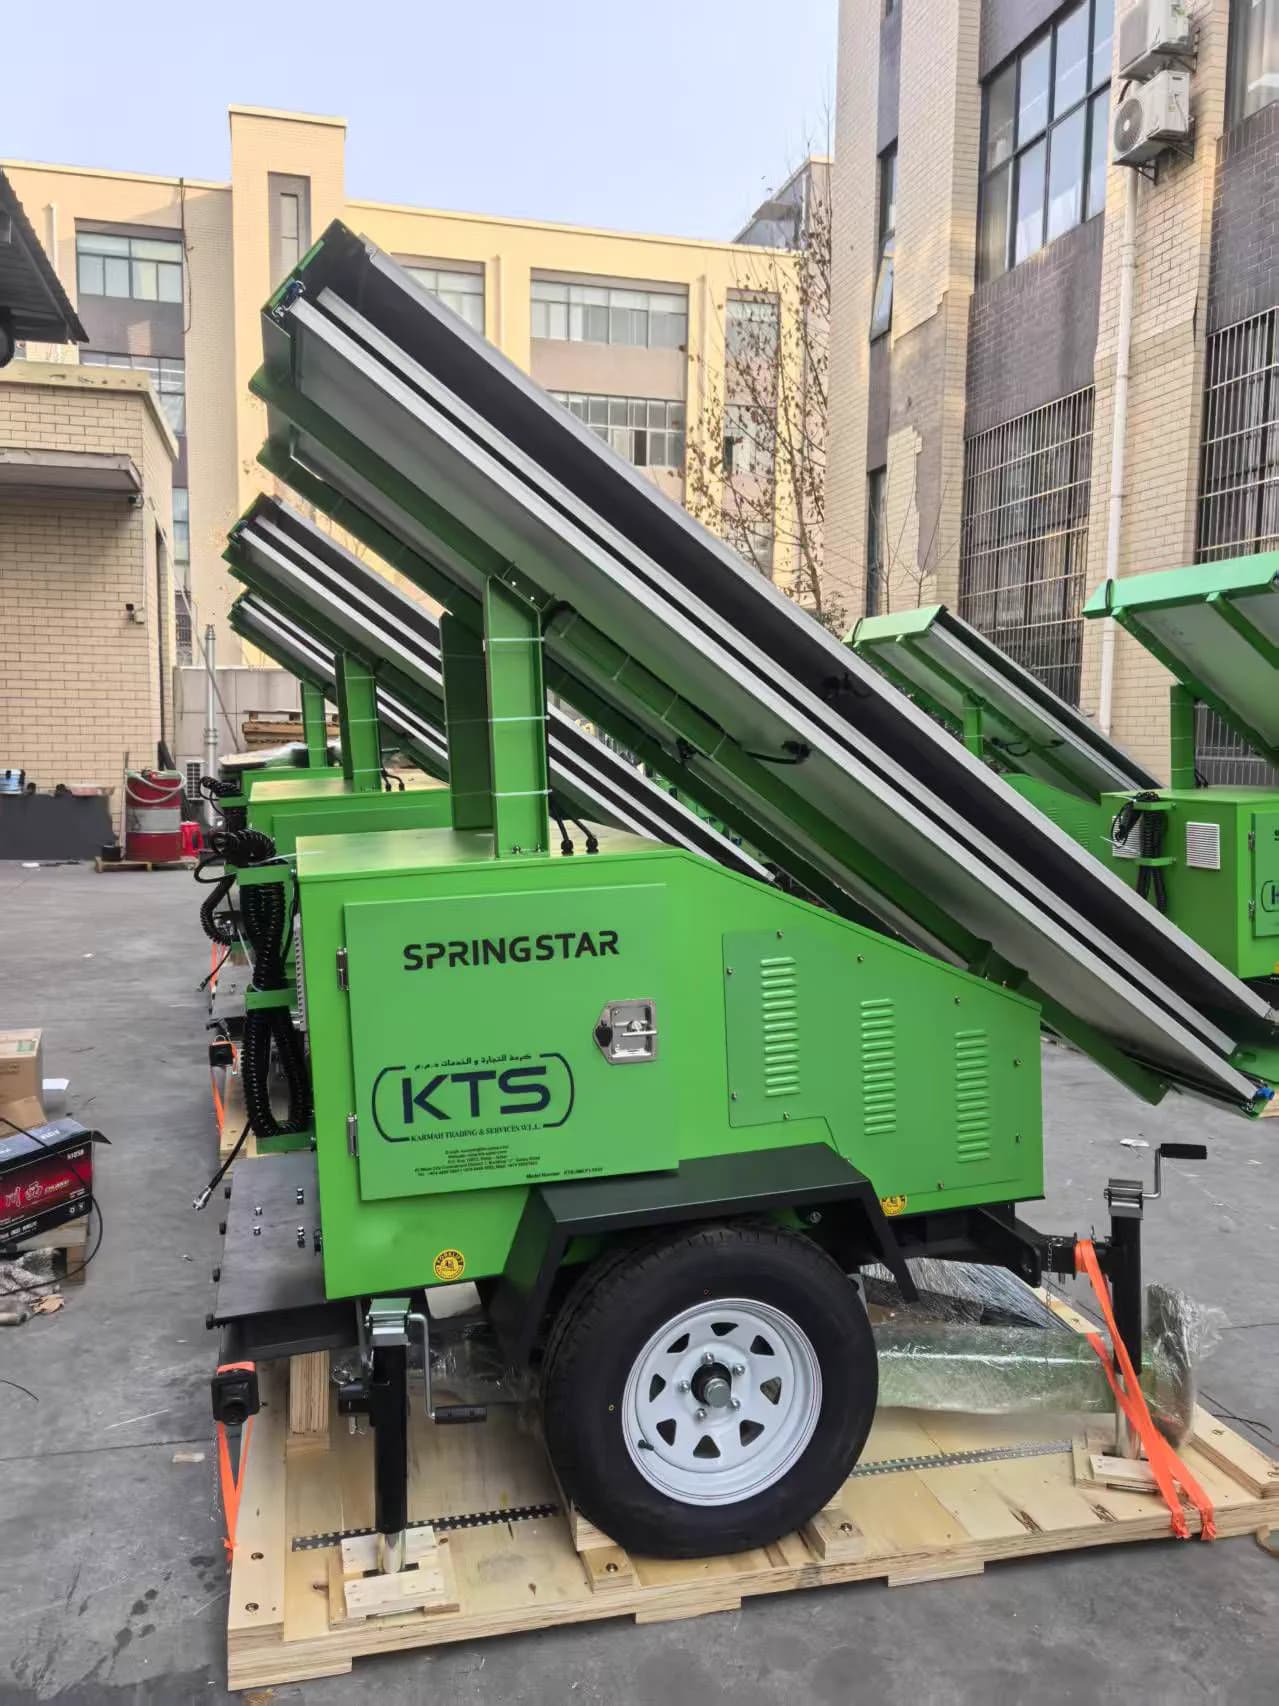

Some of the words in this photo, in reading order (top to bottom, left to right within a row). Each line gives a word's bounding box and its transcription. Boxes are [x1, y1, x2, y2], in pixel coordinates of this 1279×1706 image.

[403, 930, 619, 971] SPRINGSTAR
[402, 1066, 551, 1124] KTS
[411, 1131, 444, 1142] KARMAH
[445, 1129, 477, 1139] TRADING
[478, 1127, 484, 1136] &
[486, 1125, 519, 1135] SERVICES
